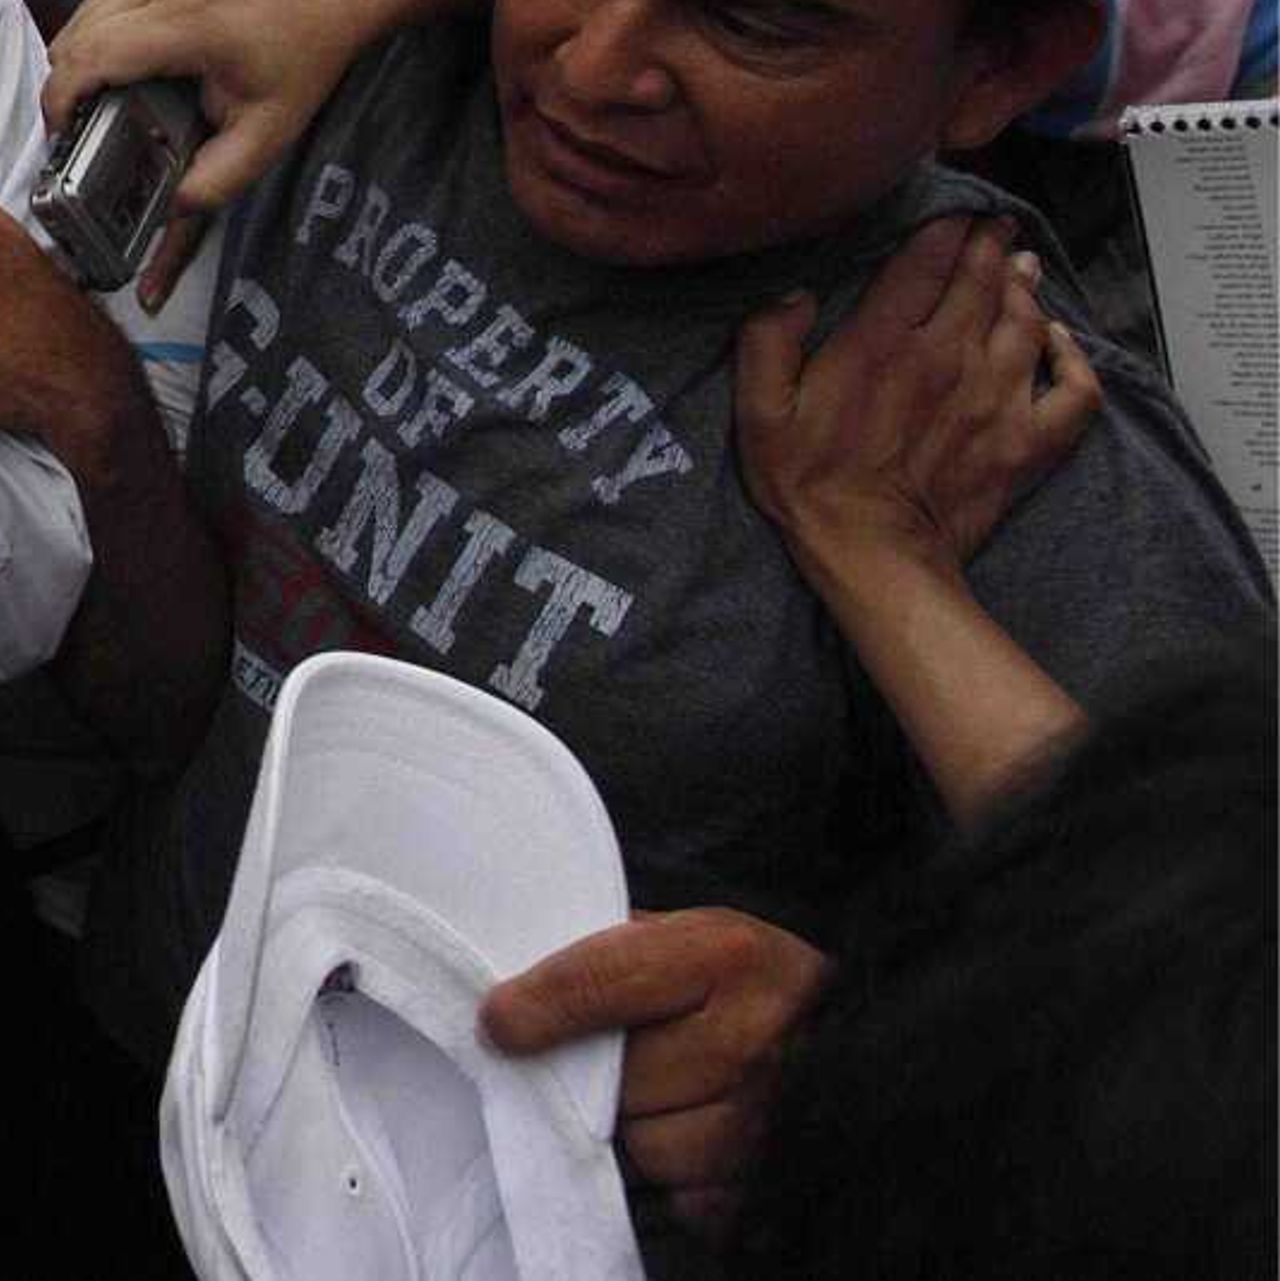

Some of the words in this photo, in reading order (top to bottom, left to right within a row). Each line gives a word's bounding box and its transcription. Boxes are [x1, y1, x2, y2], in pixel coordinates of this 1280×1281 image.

[207, 278, 634, 712] G-UNIT
[295, 163, 694, 505] PROPERTY
[362, 338, 475, 449] OF
